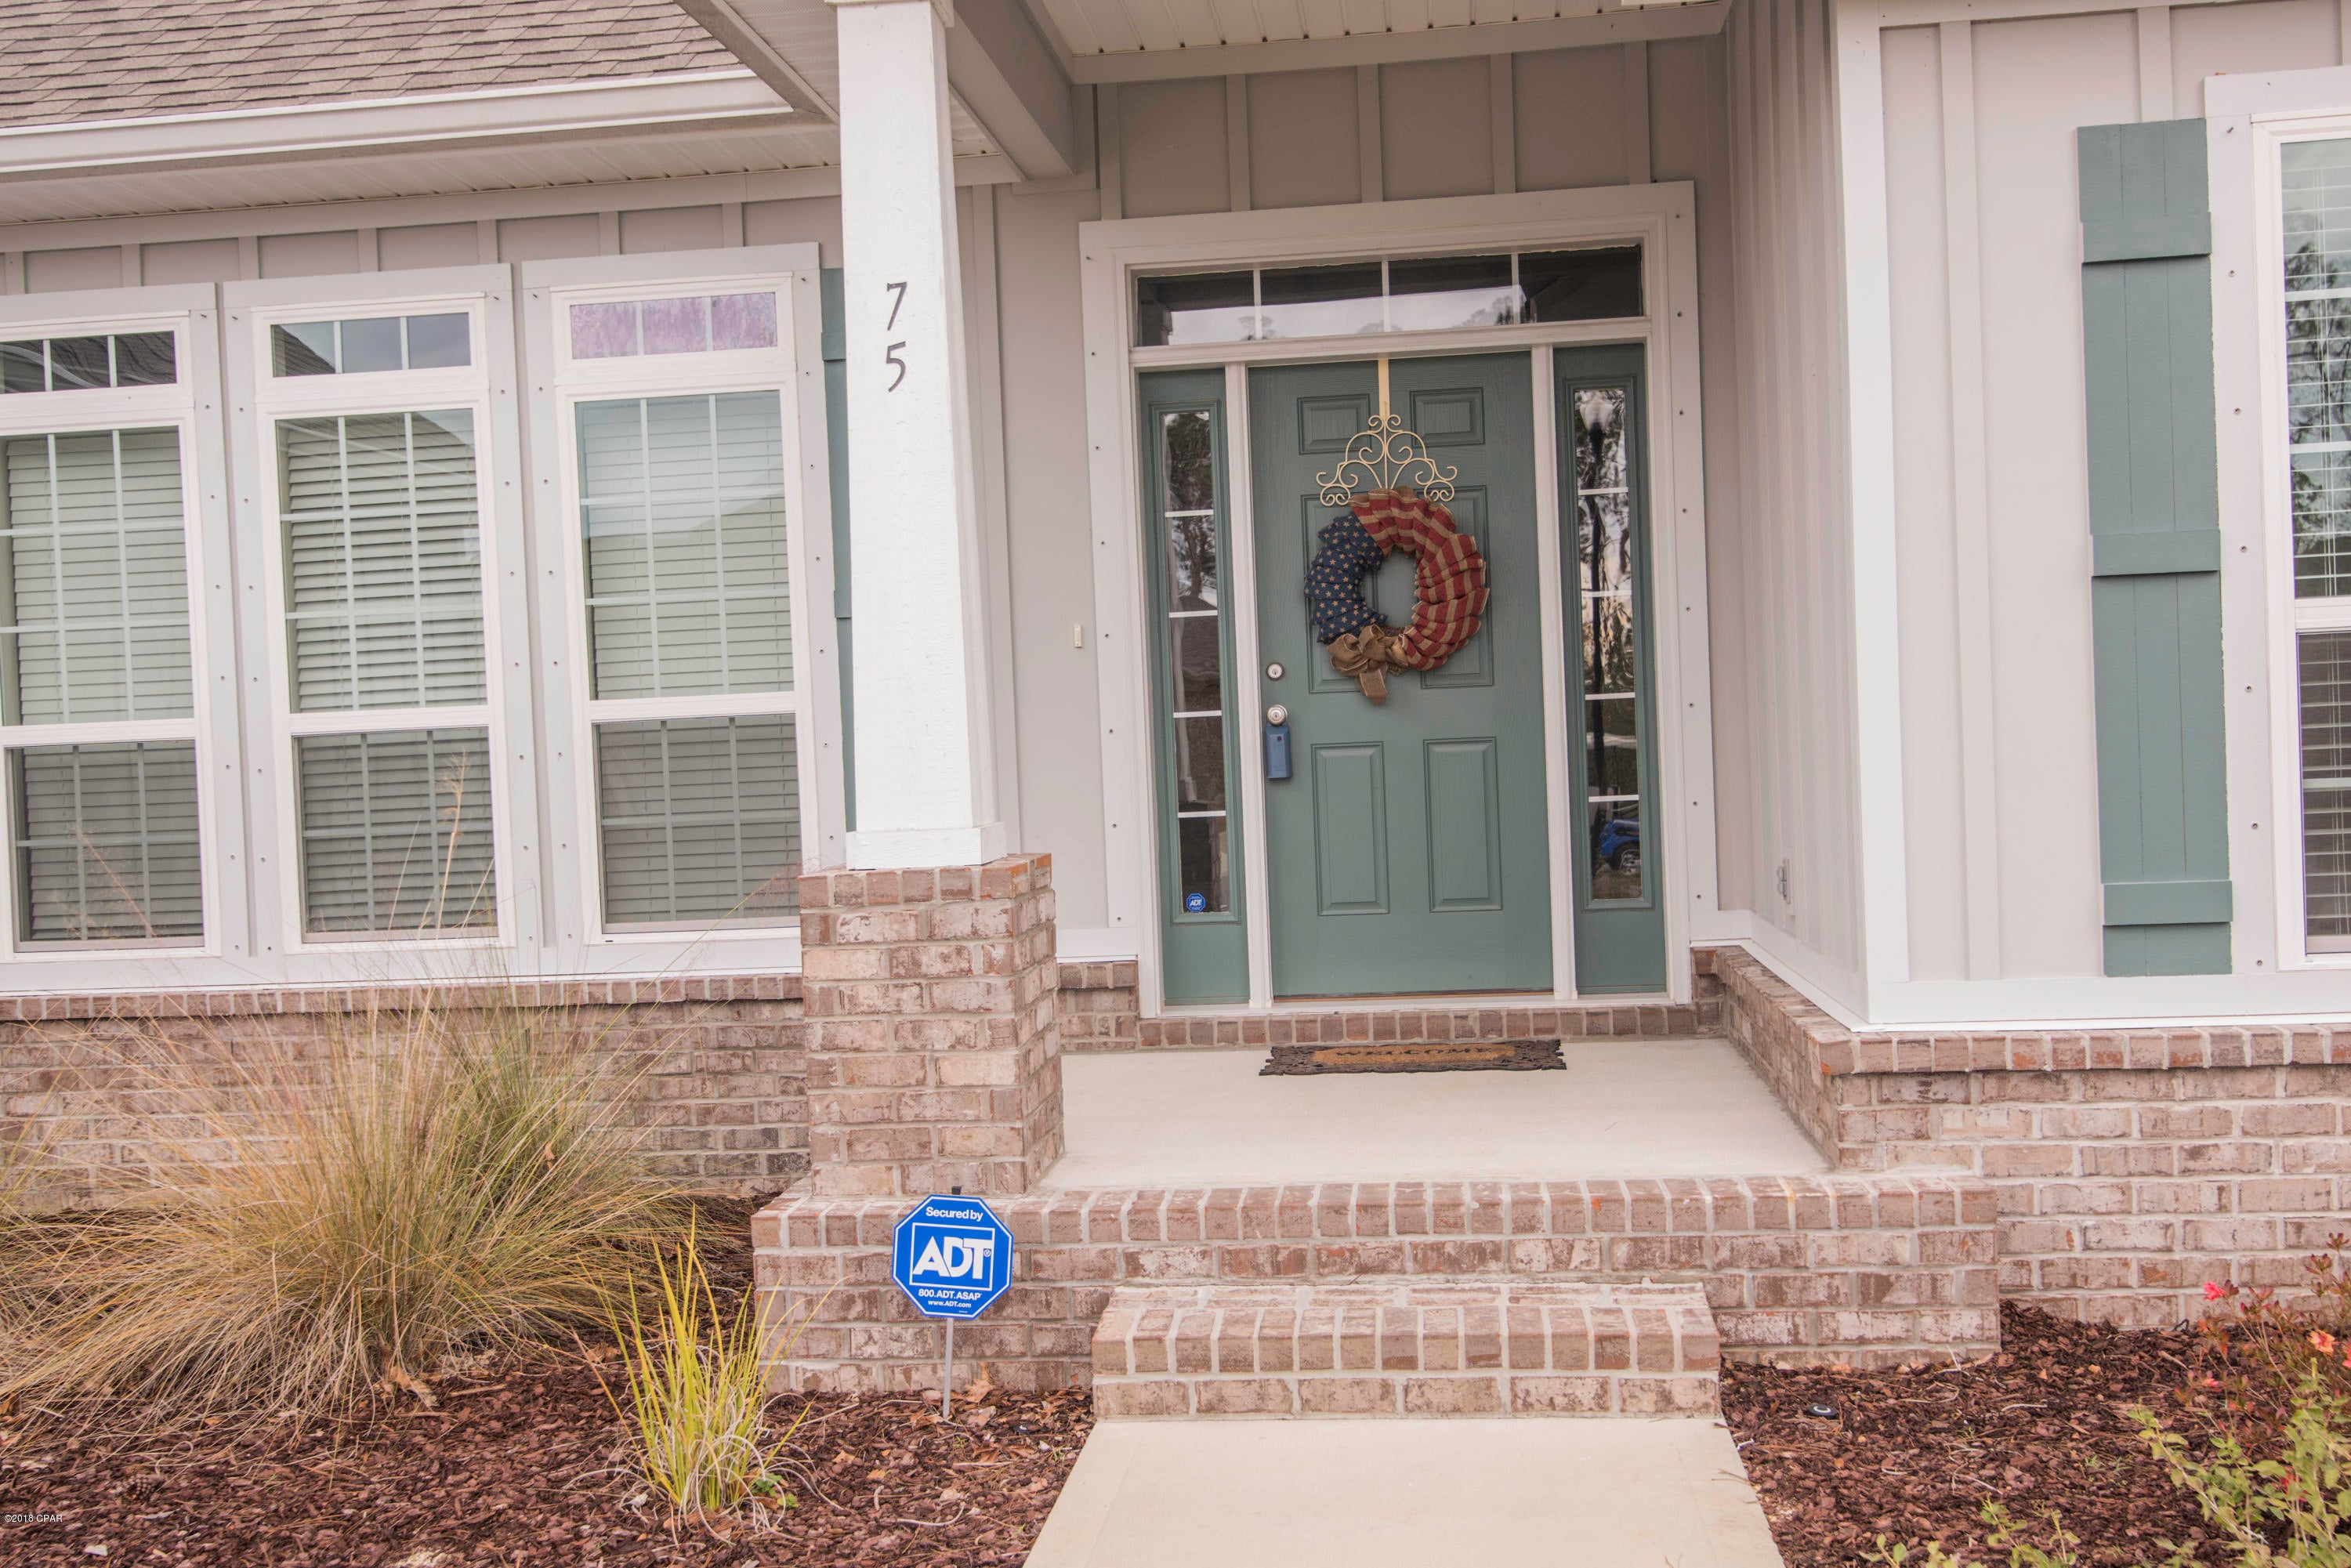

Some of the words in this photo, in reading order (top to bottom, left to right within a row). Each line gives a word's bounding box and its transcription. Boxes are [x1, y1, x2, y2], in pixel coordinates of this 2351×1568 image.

[926, 1206, 969, 1219] Secured
[970, 1209, 984, 1222] by
[912, 1236, 993, 1280] ADT
[918, 1288, 981, 1301] 800.ADT.ASAP
